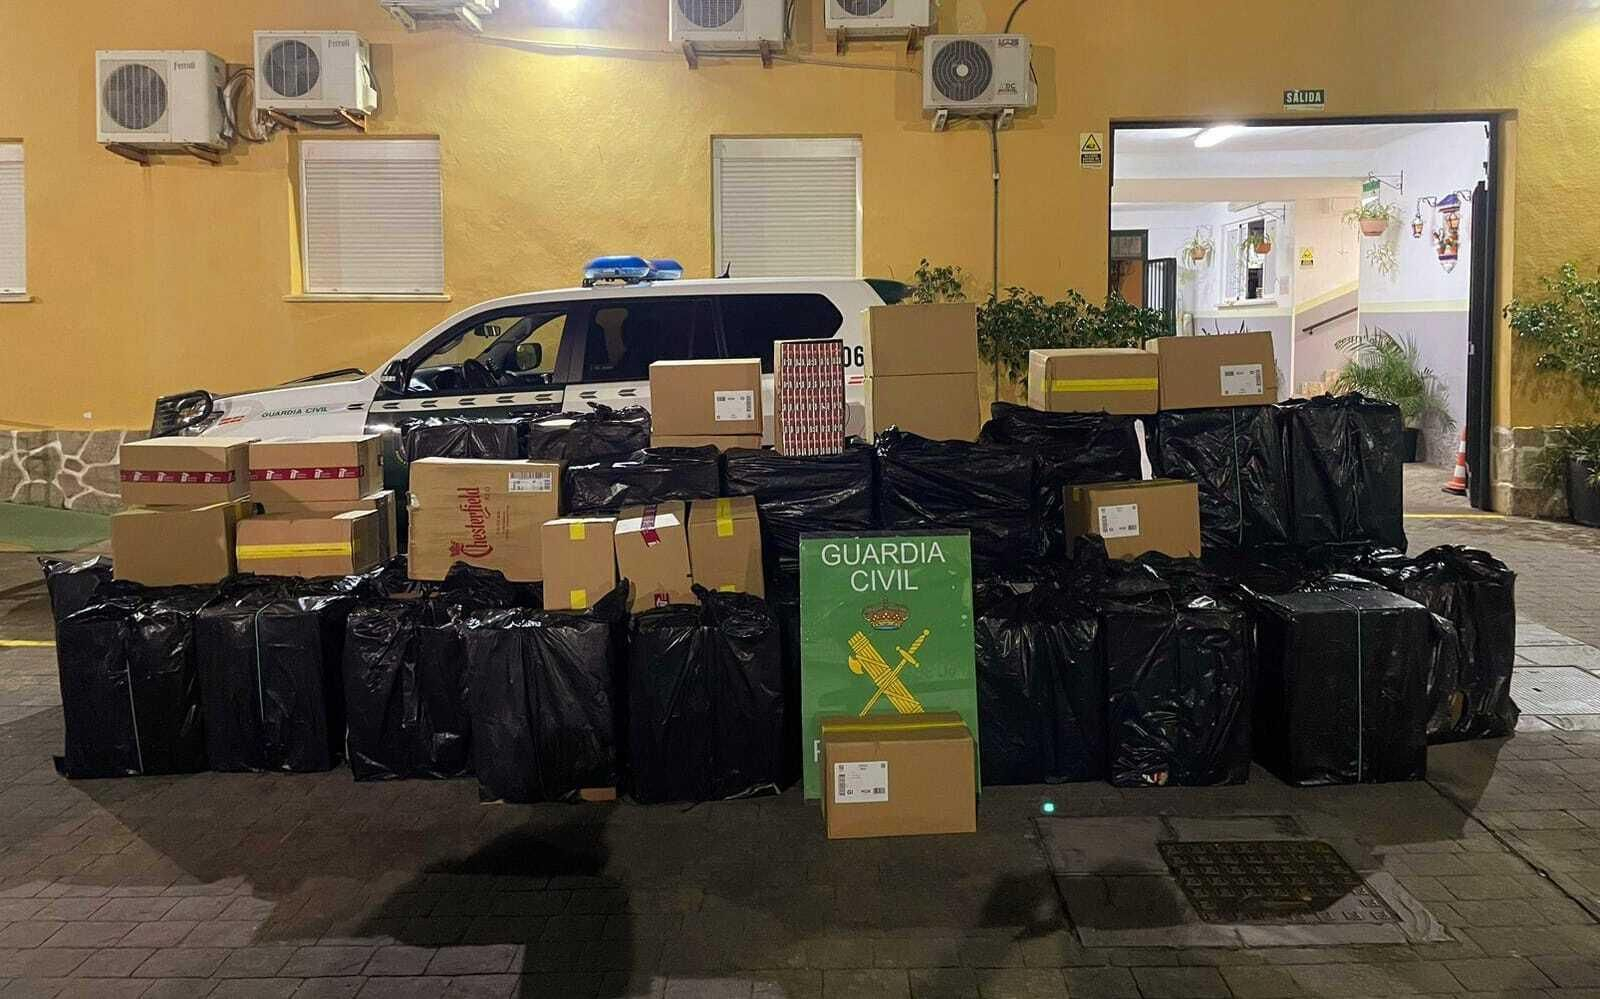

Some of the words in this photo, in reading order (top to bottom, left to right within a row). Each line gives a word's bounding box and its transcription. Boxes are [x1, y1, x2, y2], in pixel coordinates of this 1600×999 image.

[1286, 91, 1322, 104] SALIDA
[261, 408, 303, 418] GUARDIA
[304, 406, 329, 415] CIVIL
[457, 486, 494, 558] Chesterfield
[821, 541, 946, 566] GUARDIA
[850, 569, 919, 592] CIVIL
